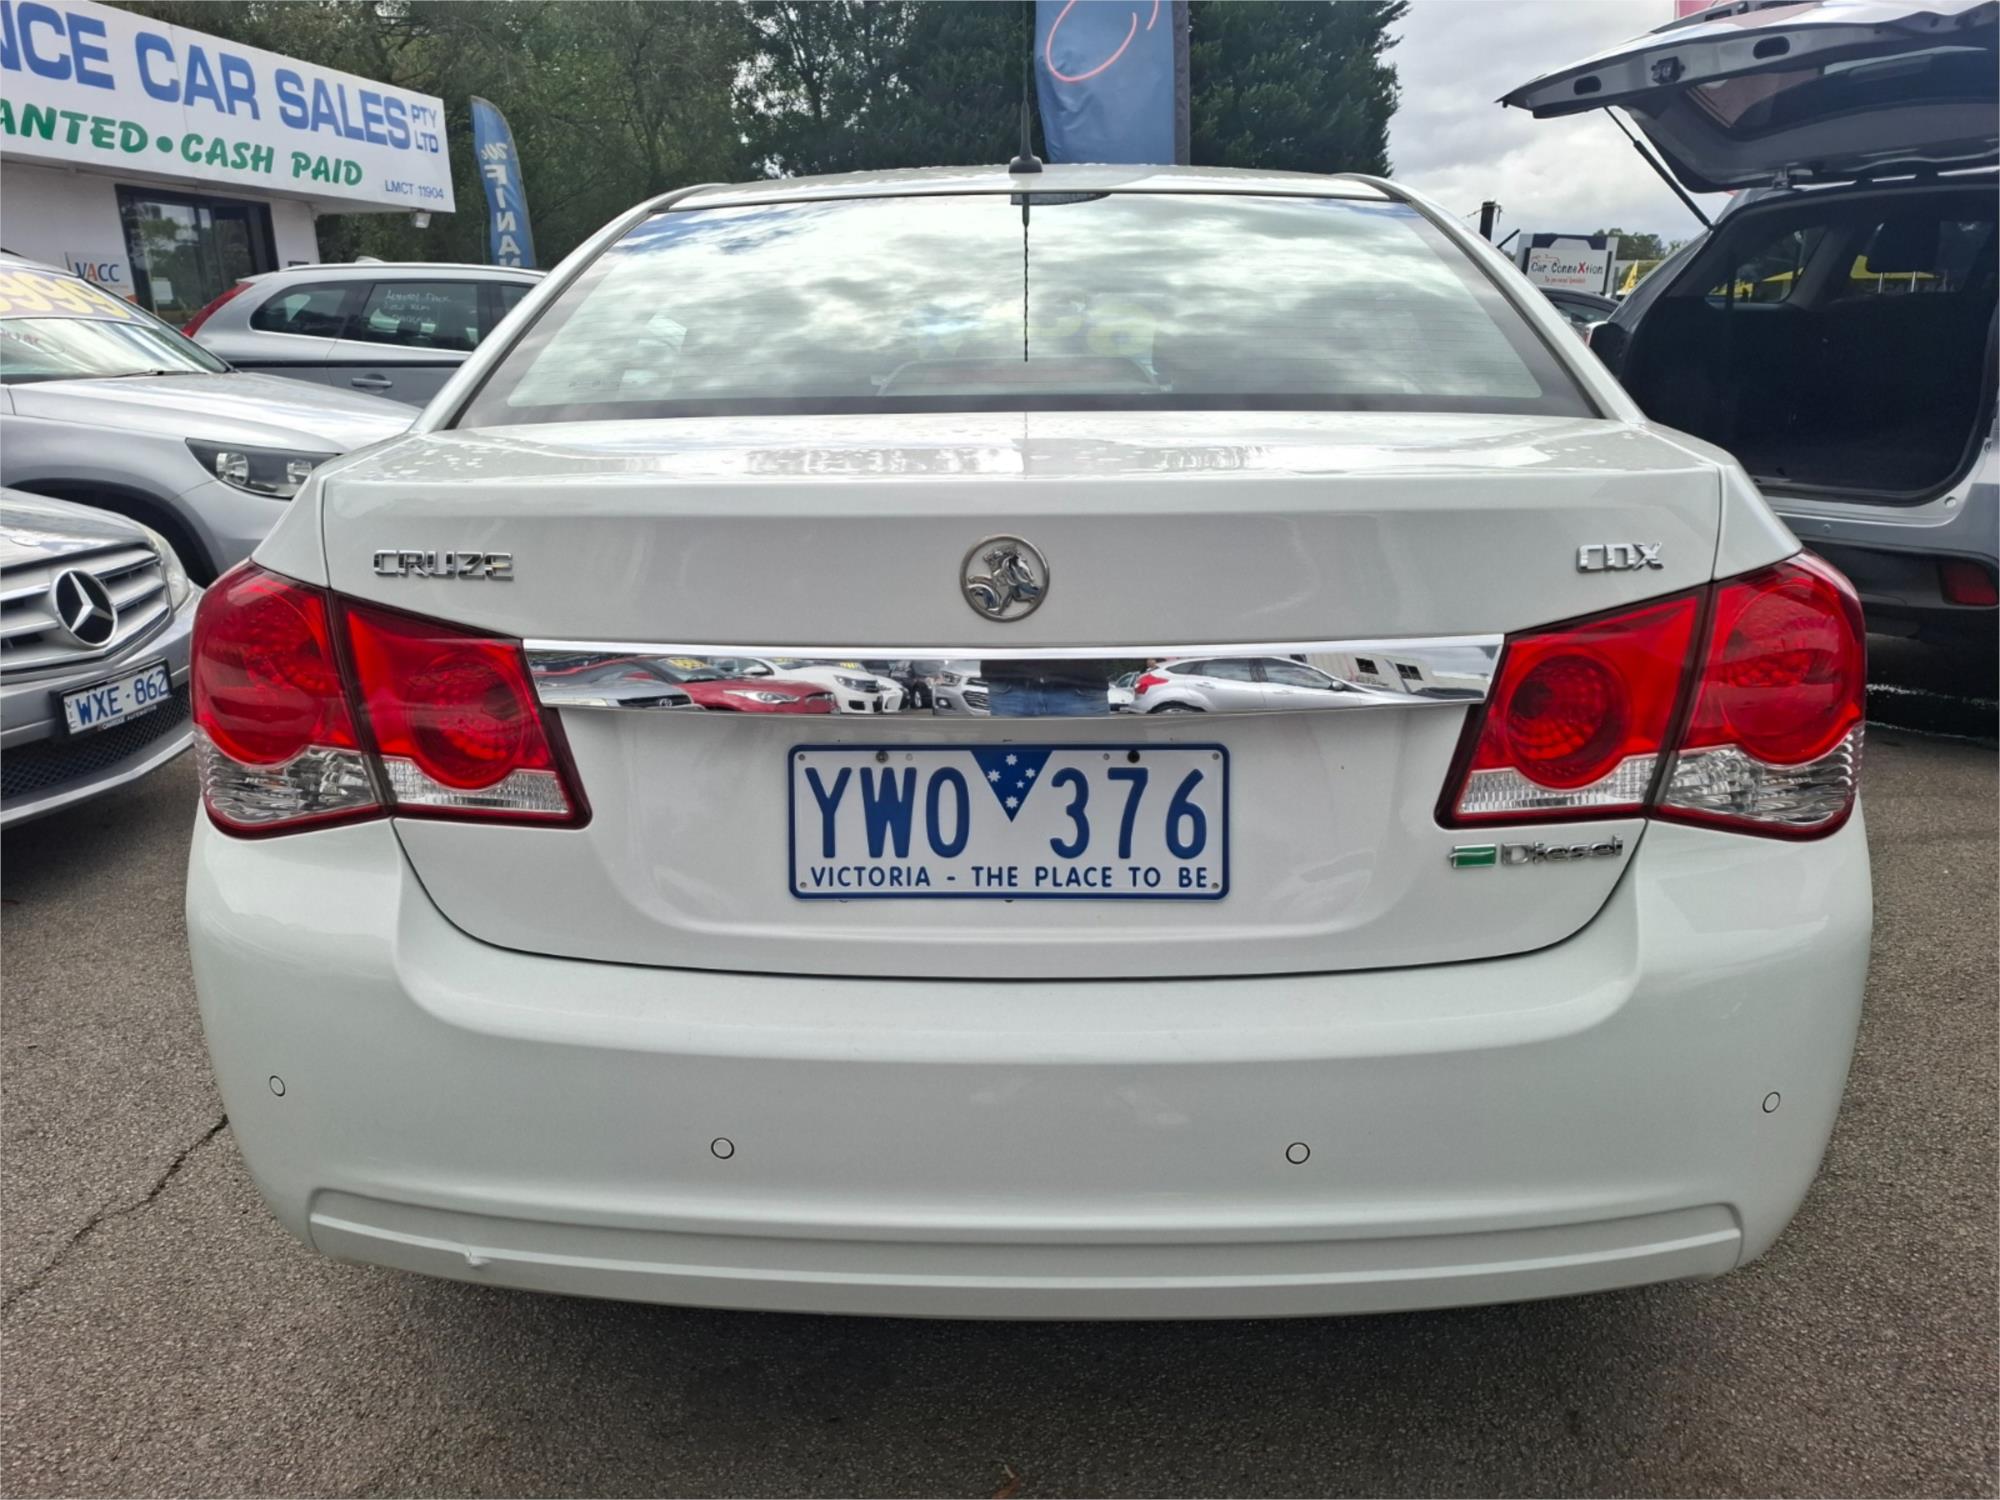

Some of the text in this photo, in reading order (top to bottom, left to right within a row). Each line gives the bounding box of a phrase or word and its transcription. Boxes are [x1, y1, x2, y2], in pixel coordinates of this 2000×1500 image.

[135, 32, 260, 120] CAR
[275, 68, 411, 150] SALES
[411, 103, 438, 127] PTY
[414, 129, 439, 154] LTD
[181, 132, 274, 174] CASH
[292, 151, 363, 186] PAID
[385, 180, 445, 200] LMCT 11904
[75, 262, 120, 282] VACC
[374, 550, 513, 581] CRUZE
[1576, 542, 1664, 574] CDX
[75, 686, 123, 725] WXE
[133, 669, 169, 706] 862
[804, 766, 1207, 860] YWO 376
[1501, 834, 1624, 865] Diesel
[810, 866, 930, 887] VICTORIA
[971, 866, 1018, 887] THE
[1034, 866, 1112, 887] PLACE
[1130, 866, 1161, 887] TO
[1179, 866, 1208, 888] BE
